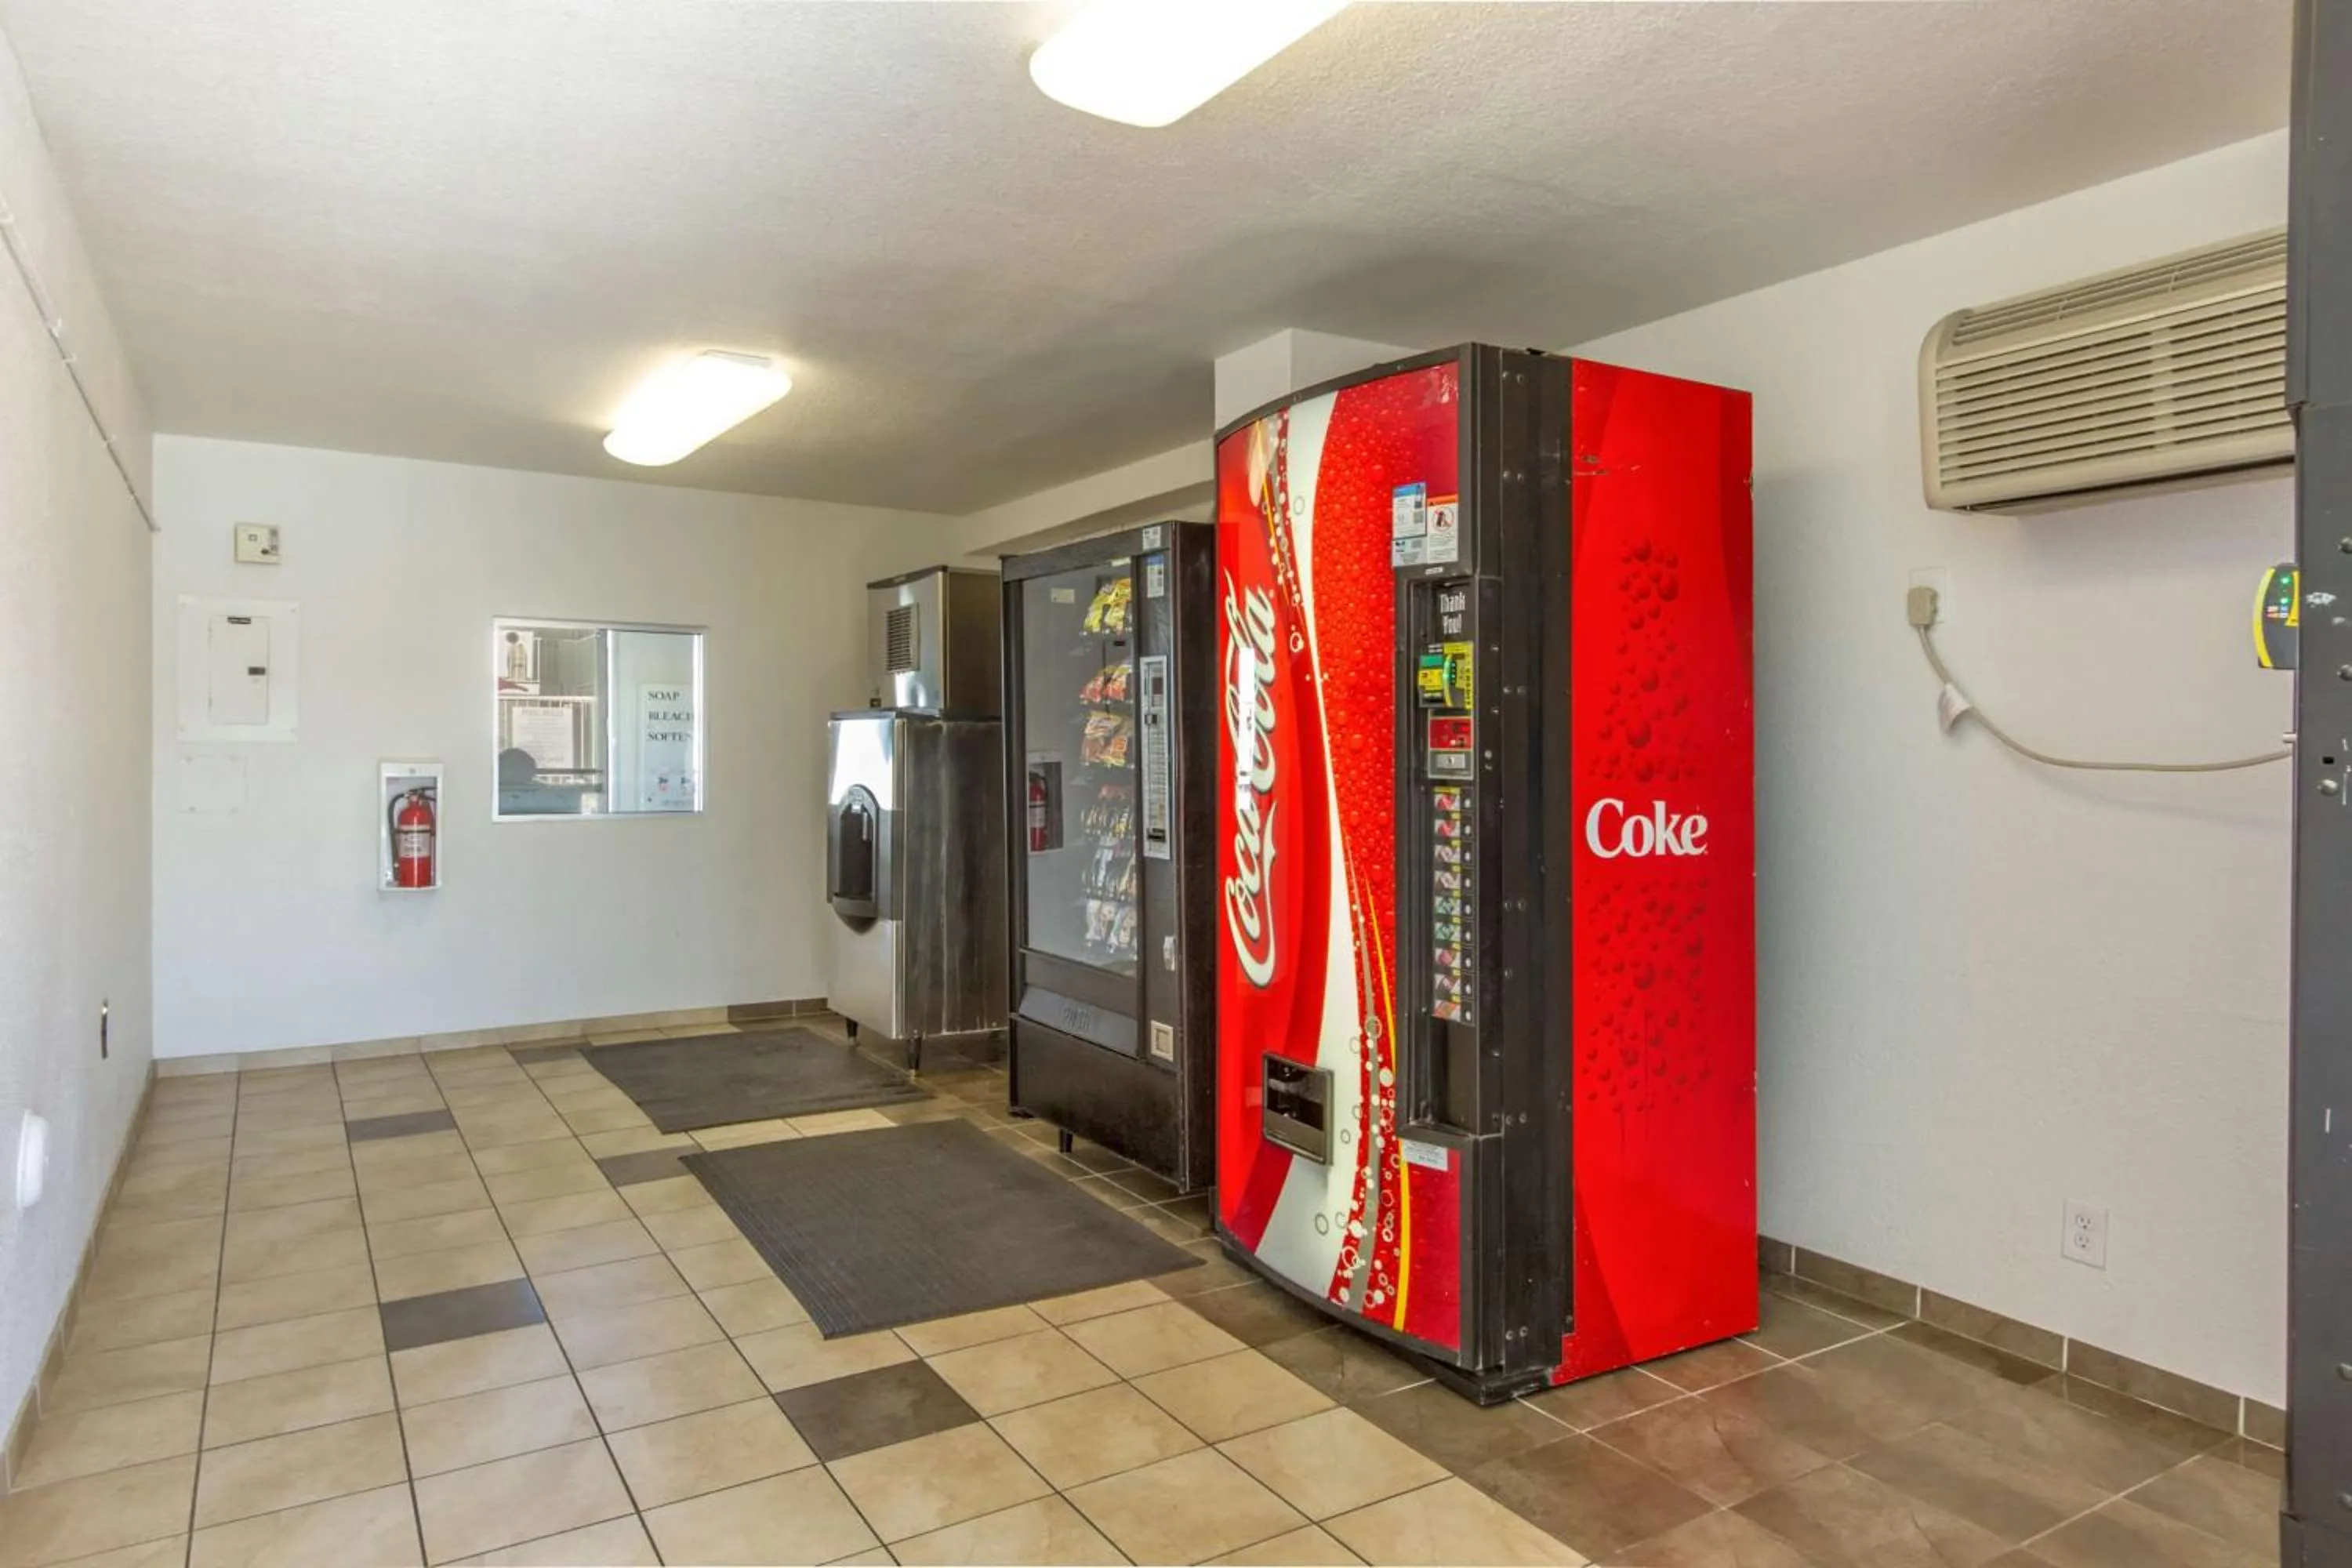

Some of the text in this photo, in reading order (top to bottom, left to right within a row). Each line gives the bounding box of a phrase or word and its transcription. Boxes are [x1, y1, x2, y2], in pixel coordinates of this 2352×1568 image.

[1439, 591, 1465, 613] Thank
[647, 691, 681, 702] SOAP
[1223, 566, 1277, 988] CocaCola
[1585, 797, 1708, 858] Coke
